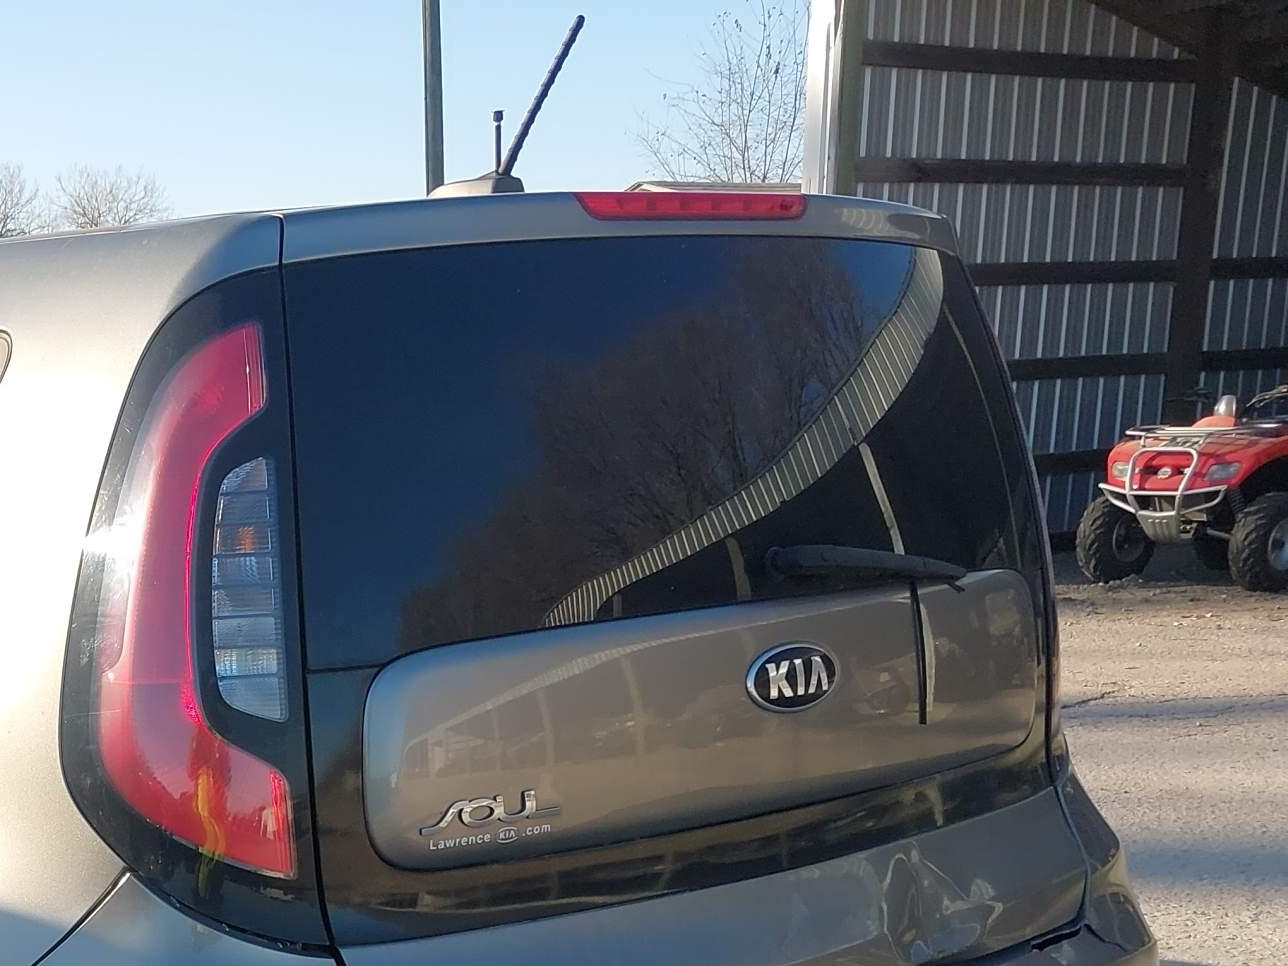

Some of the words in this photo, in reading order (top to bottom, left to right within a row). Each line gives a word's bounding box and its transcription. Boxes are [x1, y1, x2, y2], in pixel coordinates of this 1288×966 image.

[765, 656, 829, 700] KIA
[429, 833, 491, 850] Lawrence
[522, 823, 552, 837] .com
